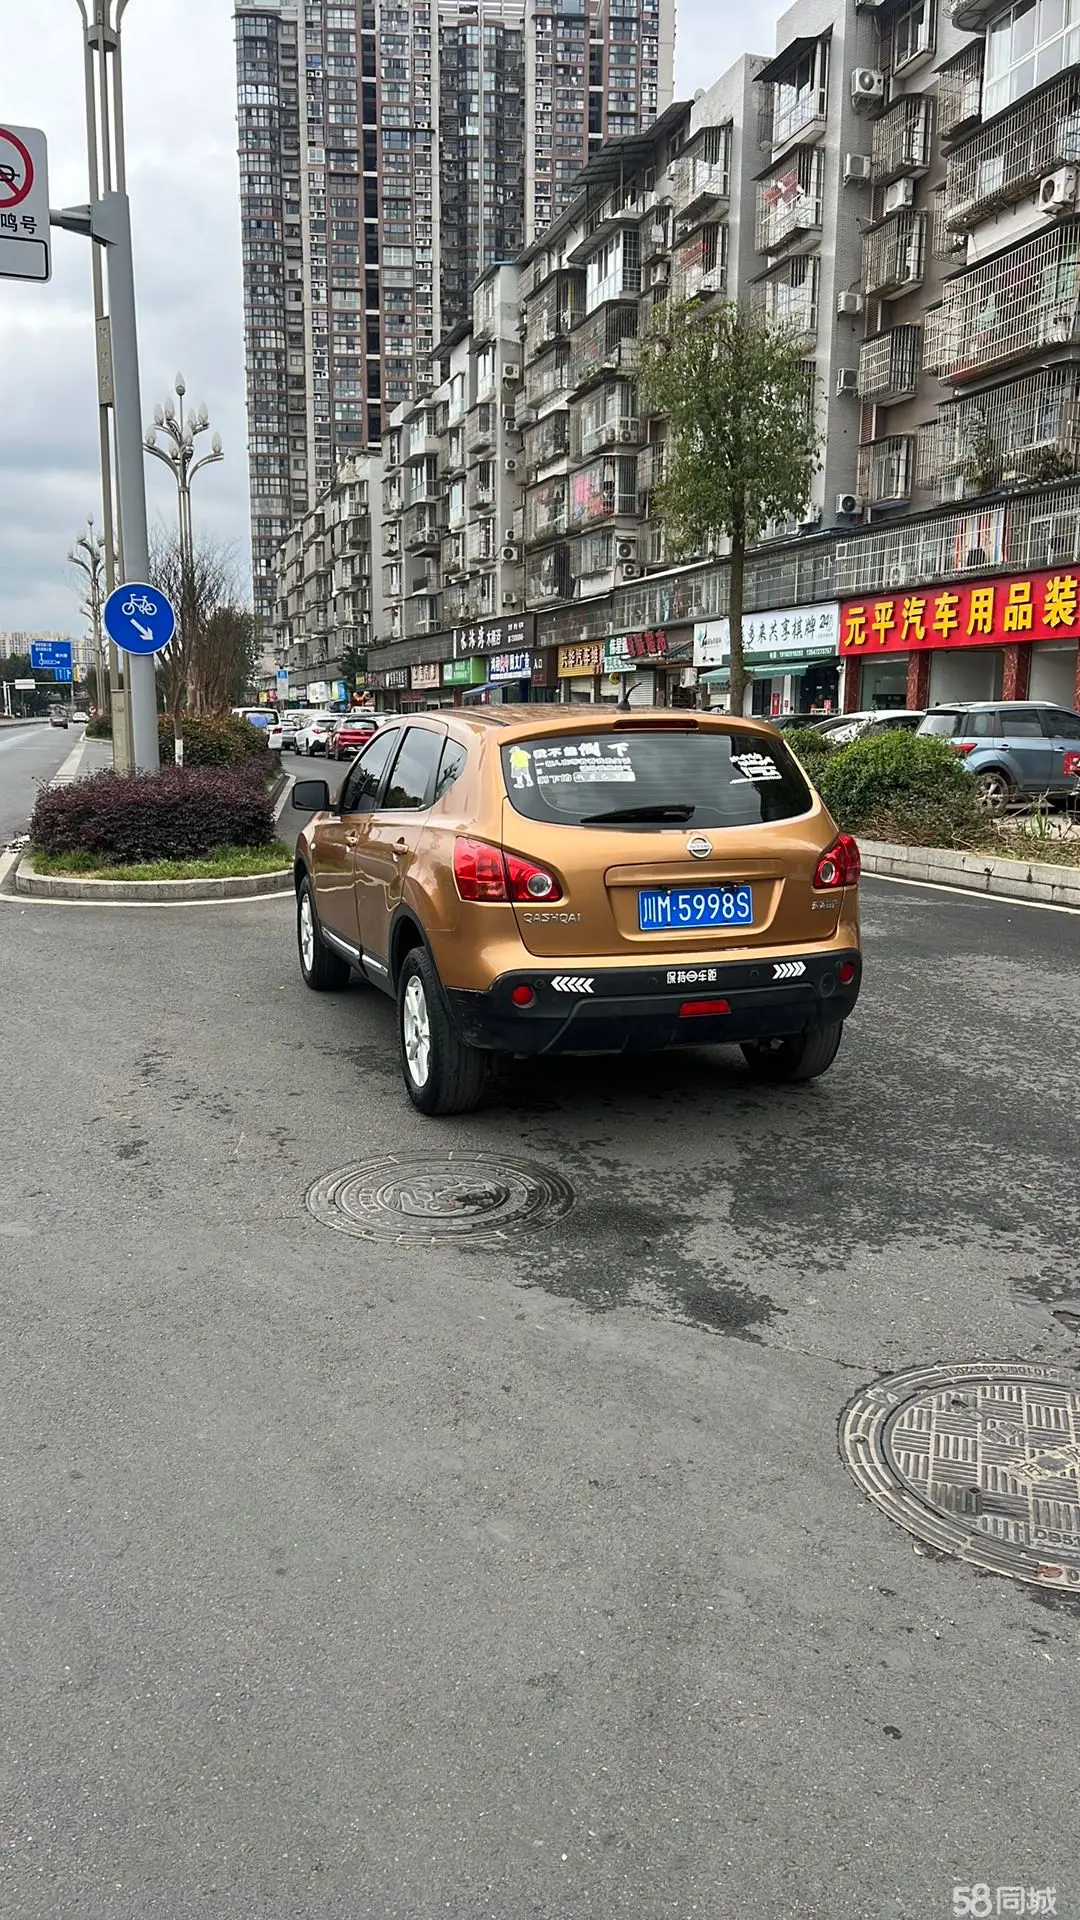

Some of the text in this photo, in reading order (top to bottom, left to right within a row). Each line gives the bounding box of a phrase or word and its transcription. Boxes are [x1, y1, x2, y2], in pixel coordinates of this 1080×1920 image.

[1, 213, 37, 234] 鸣号
[843, 575, 1078, 647] 元平汽车用品装
[523, 912, 581, 924] QASHQAI
[667, 969, 717, 984] 保持 车距
